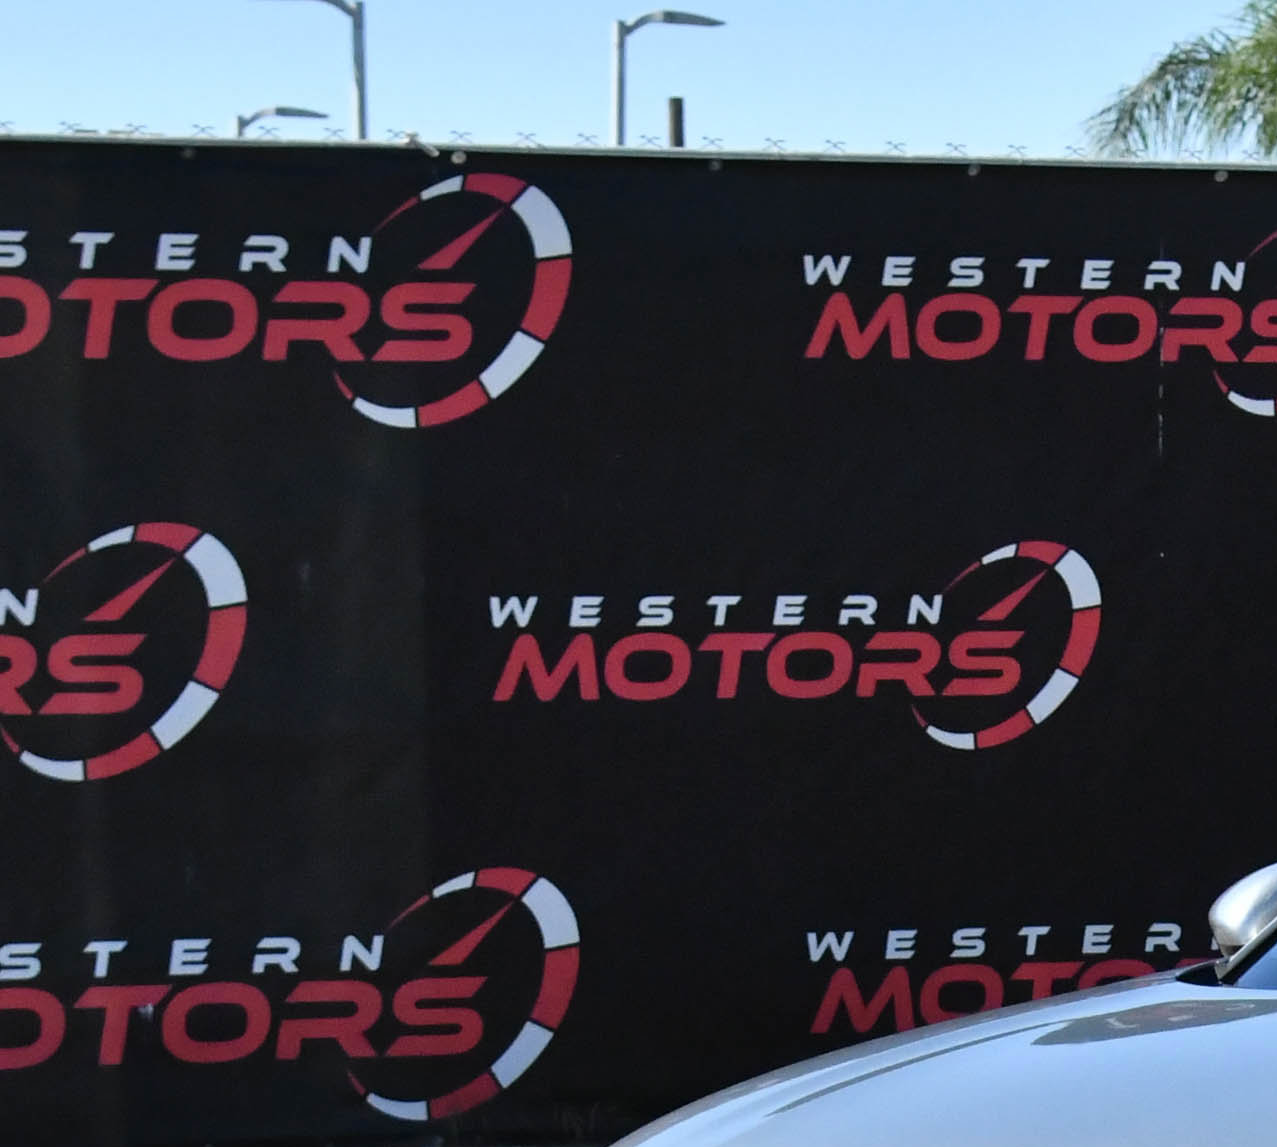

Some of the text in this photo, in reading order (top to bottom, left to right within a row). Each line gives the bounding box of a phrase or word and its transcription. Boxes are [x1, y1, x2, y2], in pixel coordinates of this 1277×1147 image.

[803, 254, 1246, 292] WESTERN
[489, 595, 943, 628] WESTERN
[493, 631, 1025, 702] MOTORS
[807, 922, 1219, 962] WESTER
